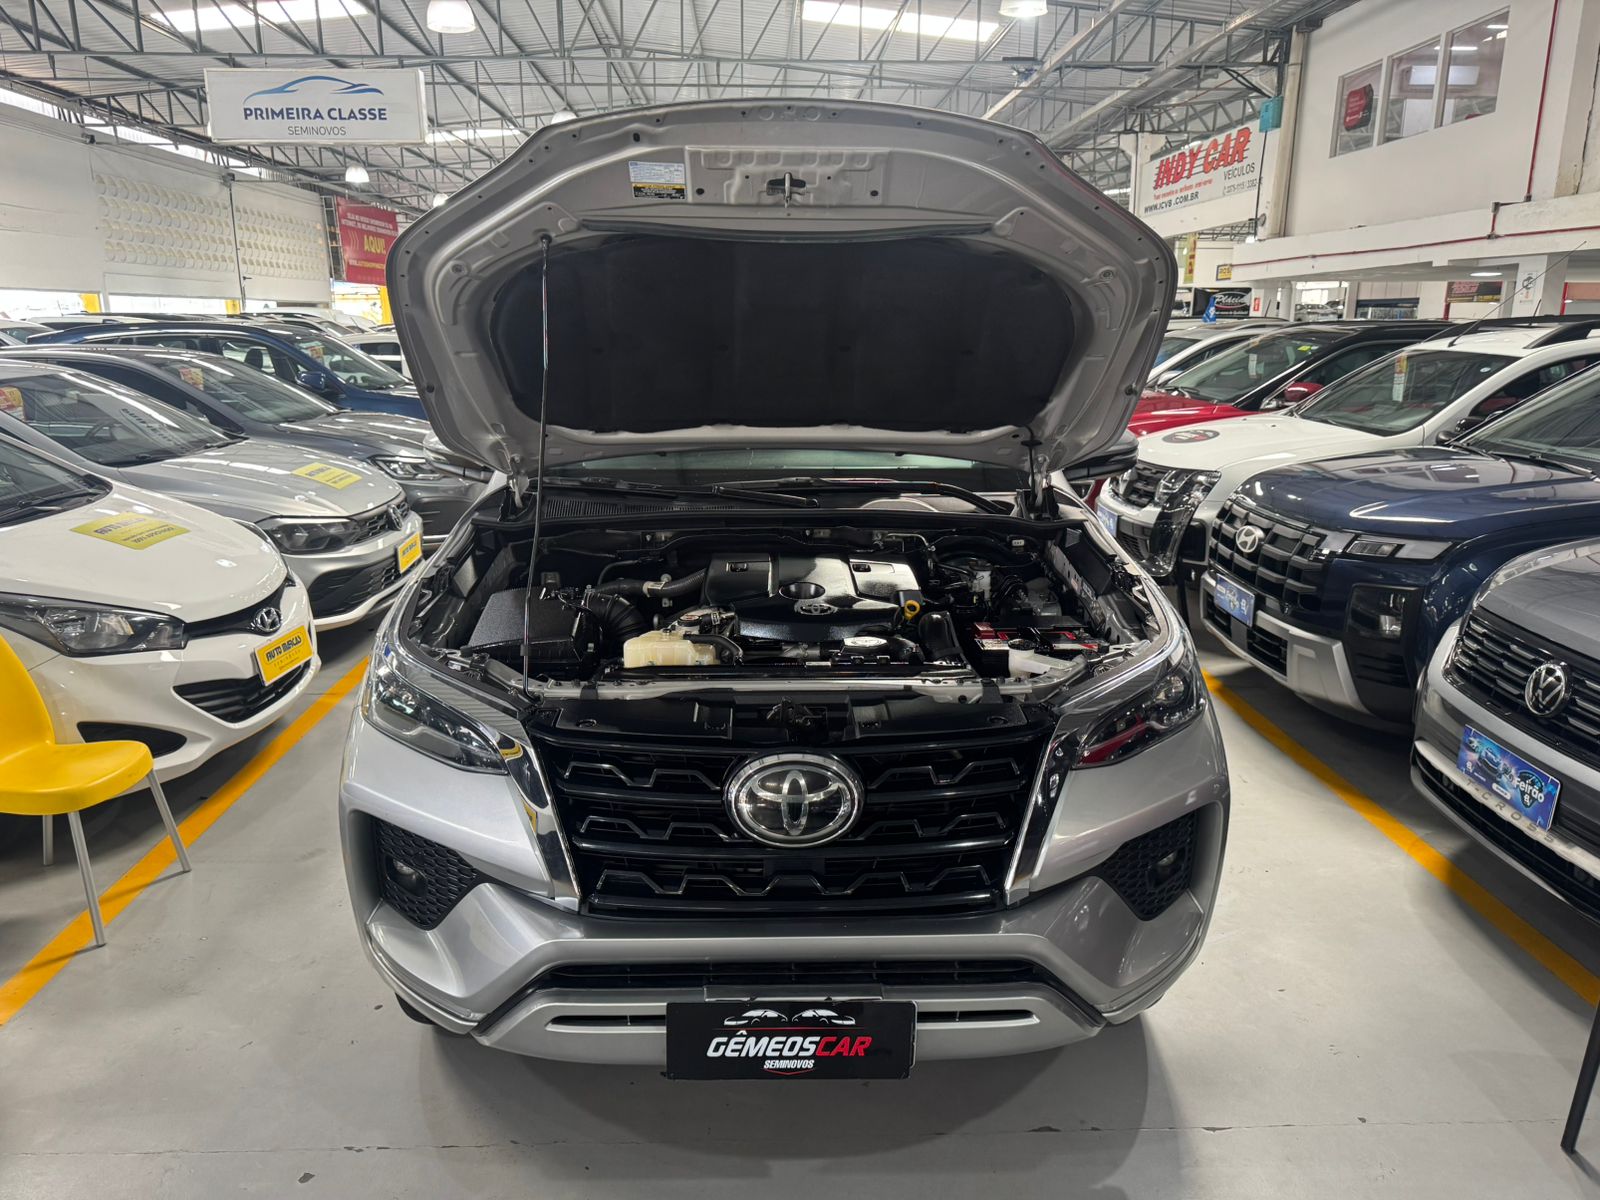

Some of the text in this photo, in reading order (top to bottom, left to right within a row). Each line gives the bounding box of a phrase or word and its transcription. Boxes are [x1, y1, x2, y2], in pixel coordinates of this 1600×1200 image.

[243, 107, 388, 121] PRIMEIRA CLASSE
[287, 126, 347, 136] SEMINOVOS
[1153, 143, 1203, 190] INDY
[1202, 127, 1253, 174] CAR
[265, 645, 282, 661] AUTO
[1513, 778, 1545, 803] Feirão
[763, 1059, 815, 1069] SEMINOVOS
